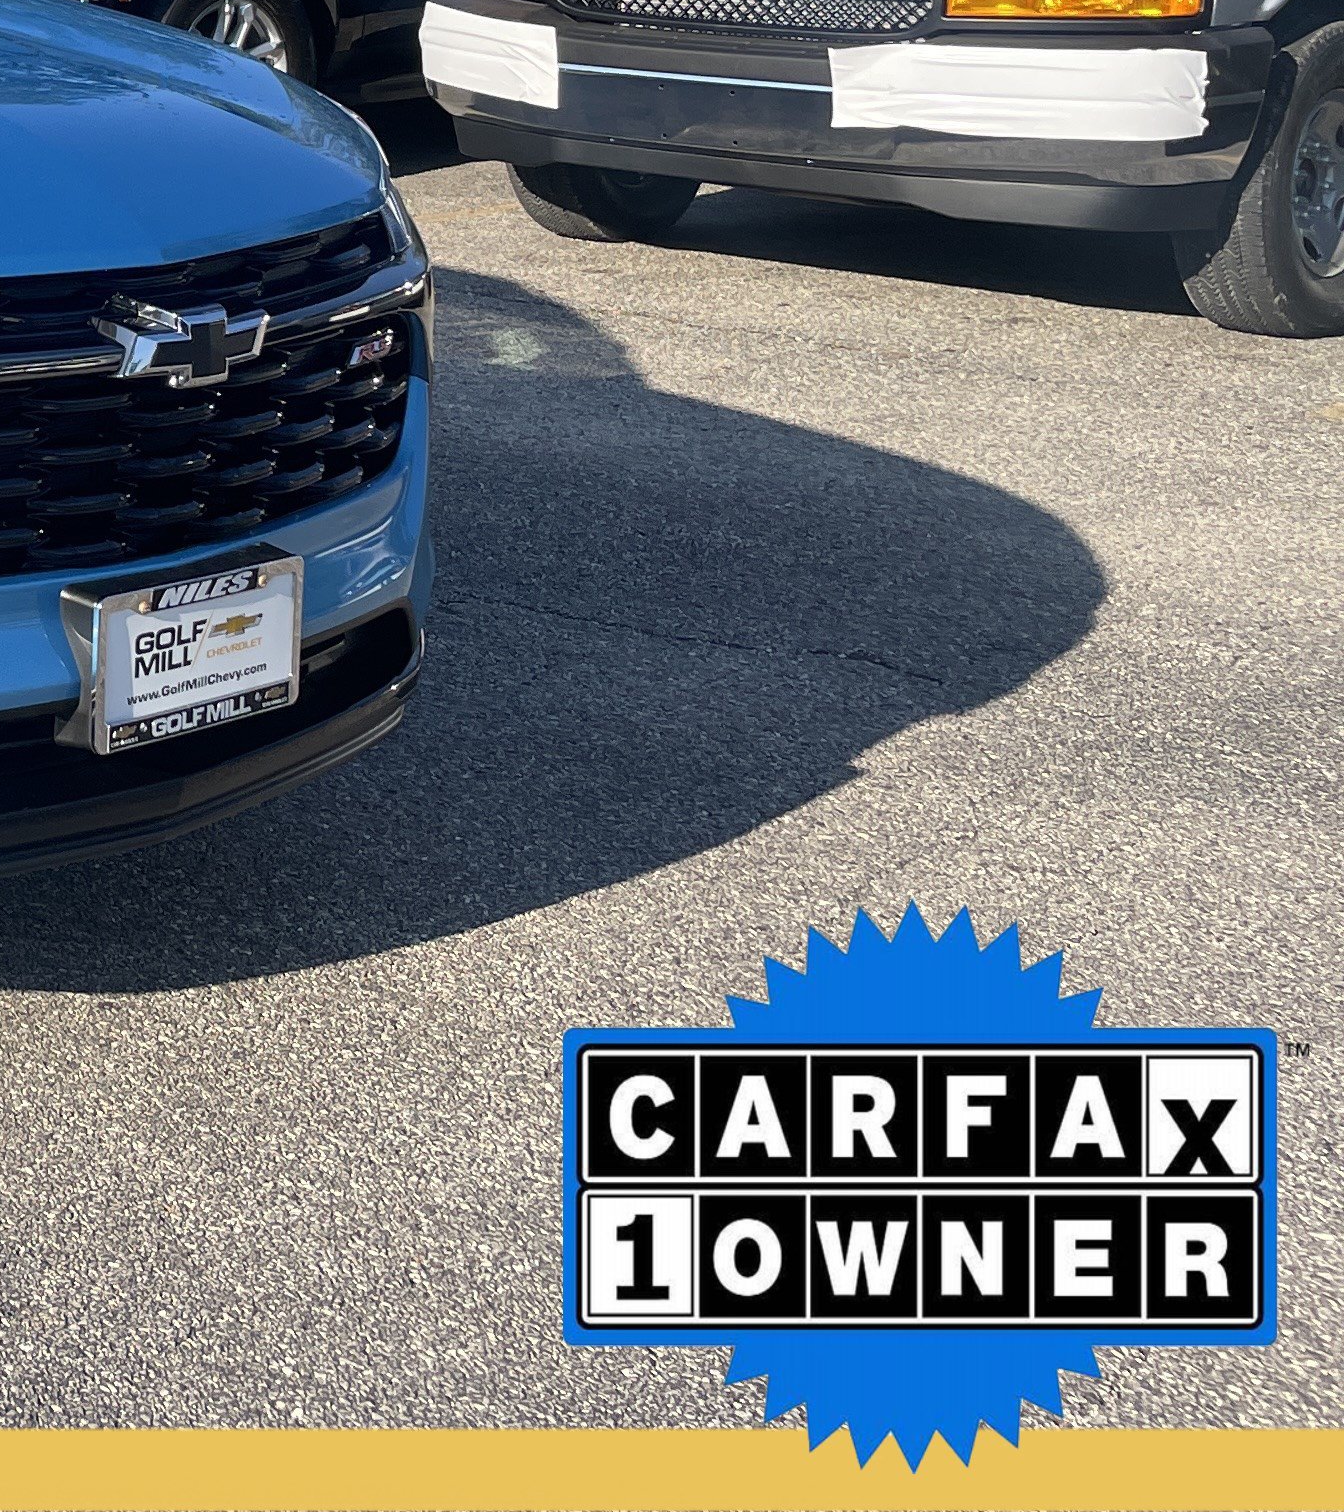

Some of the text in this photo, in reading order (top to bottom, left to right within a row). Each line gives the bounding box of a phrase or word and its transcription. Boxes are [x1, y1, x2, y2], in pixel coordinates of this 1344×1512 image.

[157, 570, 253, 609] NILES
[134, 618, 208, 655] GOLF
[206, 636, 263, 659] CHEVROLET
[134, 645, 193, 678] MILL
[126, 661, 267, 705] www.GolfMillChevy.com
